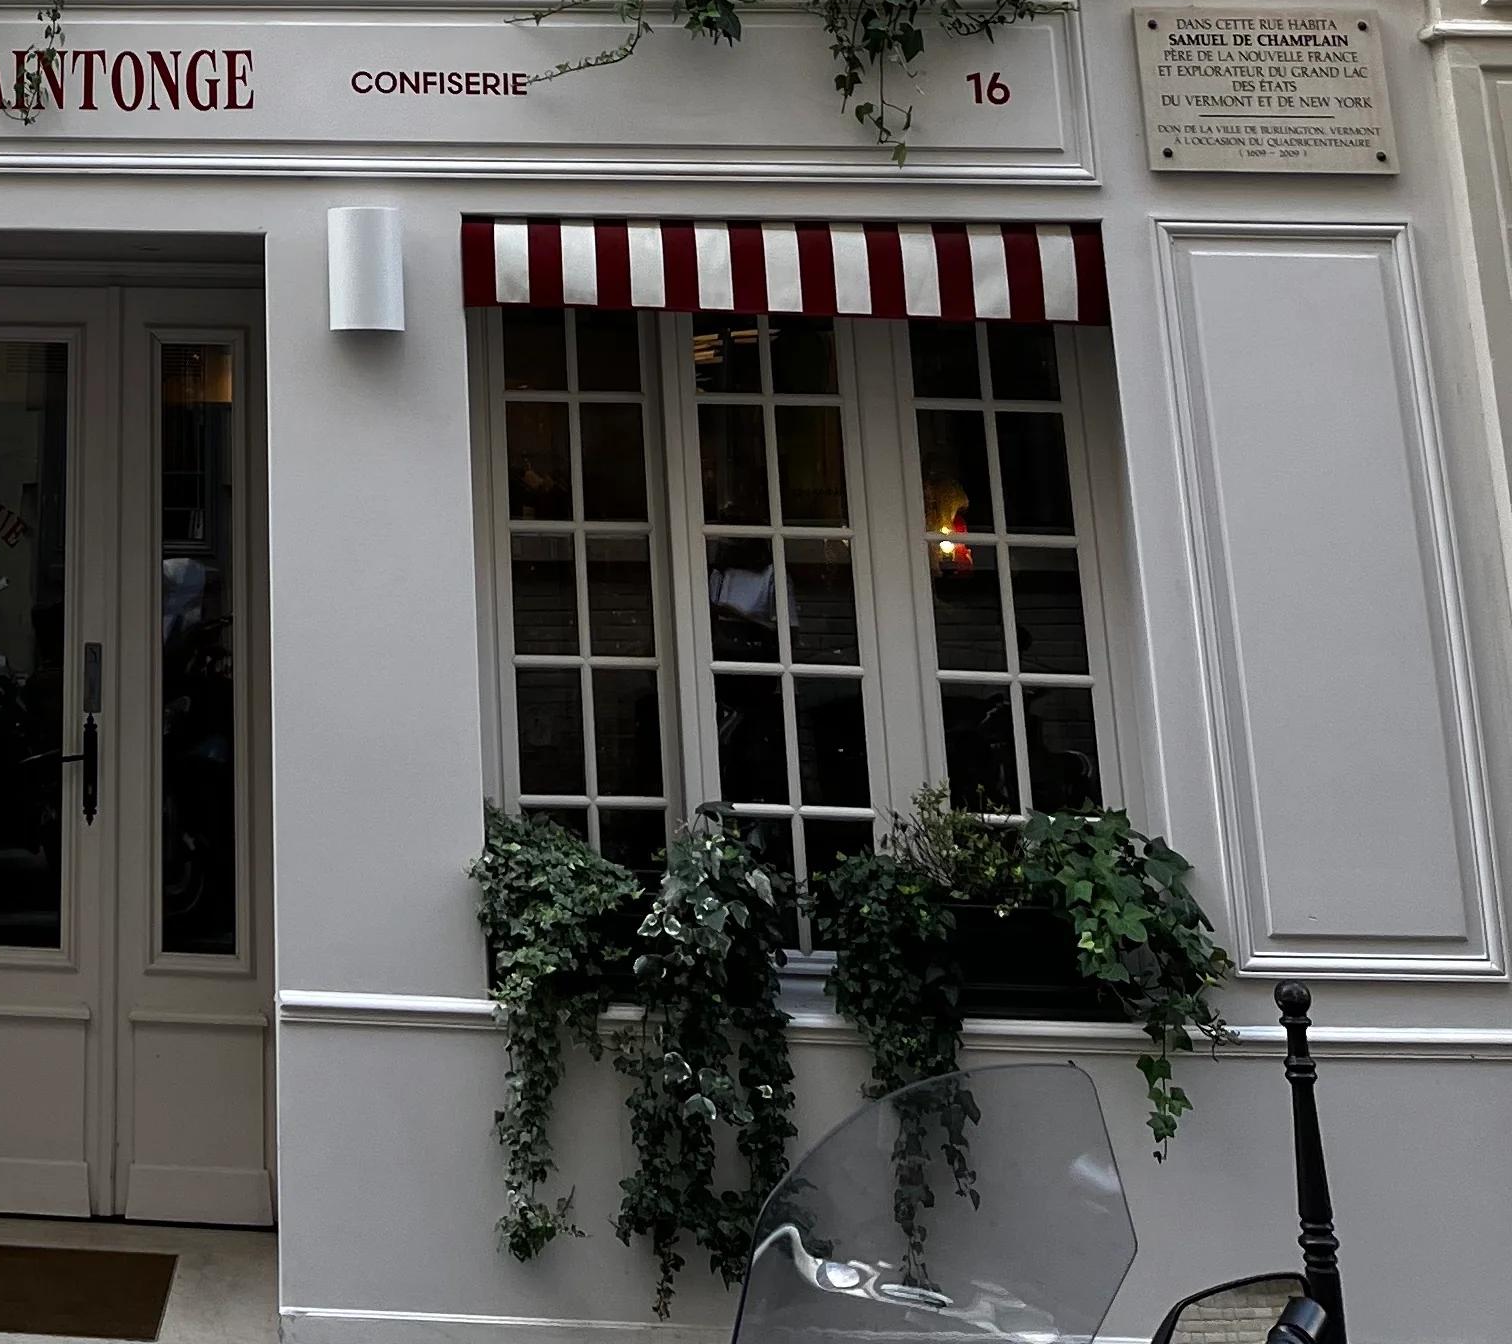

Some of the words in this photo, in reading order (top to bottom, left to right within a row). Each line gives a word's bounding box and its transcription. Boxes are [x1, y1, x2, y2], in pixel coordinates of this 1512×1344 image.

[1176, 18, 1212, 30] DANS
[1215, 19, 1255, 30] CETTE
[1259, 19, 1284, 30] RUE
[1288, 19, 1337, 30] HABITA
[1168, 34, 1227, 46] SAMUEL
[1232, 34, 1252, 46] DE
[1257, 34, 1348, 47] CHAMPLAIN
[1164, 48, 1193, 61] PÈRE
[1197, 50, 1213, 61] DE
[1218, 51, 1234, 61] LA
[1239, 51, 1303, 62] NOUVELLE
[1308, 51, 1358, 63] FRANCE
[1158, 65, 1172, 76] ET
[1177, 65, 1264, 77] EXPLORATEUR
[1269, 66, 1287, 77] DU
[1291, 67, 1339, 77] GRAND
[1344, 67, 1368, 78] LAC
[351, 70, 528, 96] CONFISERIE
[966, 72, 1011, 105] 16
[1232, 80, 1255, 92] DES
[1259, 78, 1297, 92] ÉTATS
[1161, 95, 1181, 106] DU
[1185, 95, 1252, 107] VERMONT
[1257, 96, 1272, 107] ET
[1278, 96, 1294, 107] DE
[1299, 97, 1330, 107] NEW
[1335, 97, 1373, 108] YORK
[1158, 124, 1181, 133] DON
[1185, 125, 1198, 133] DE
[1200, 125, 1213, 133] LA
[1216, 125, 1241, 134] VILLE
[1245, 125, 1257, 134] DE
[1331, 126, 1381, 136] VERMONT
[1249, 138, 1263, 146] DU
